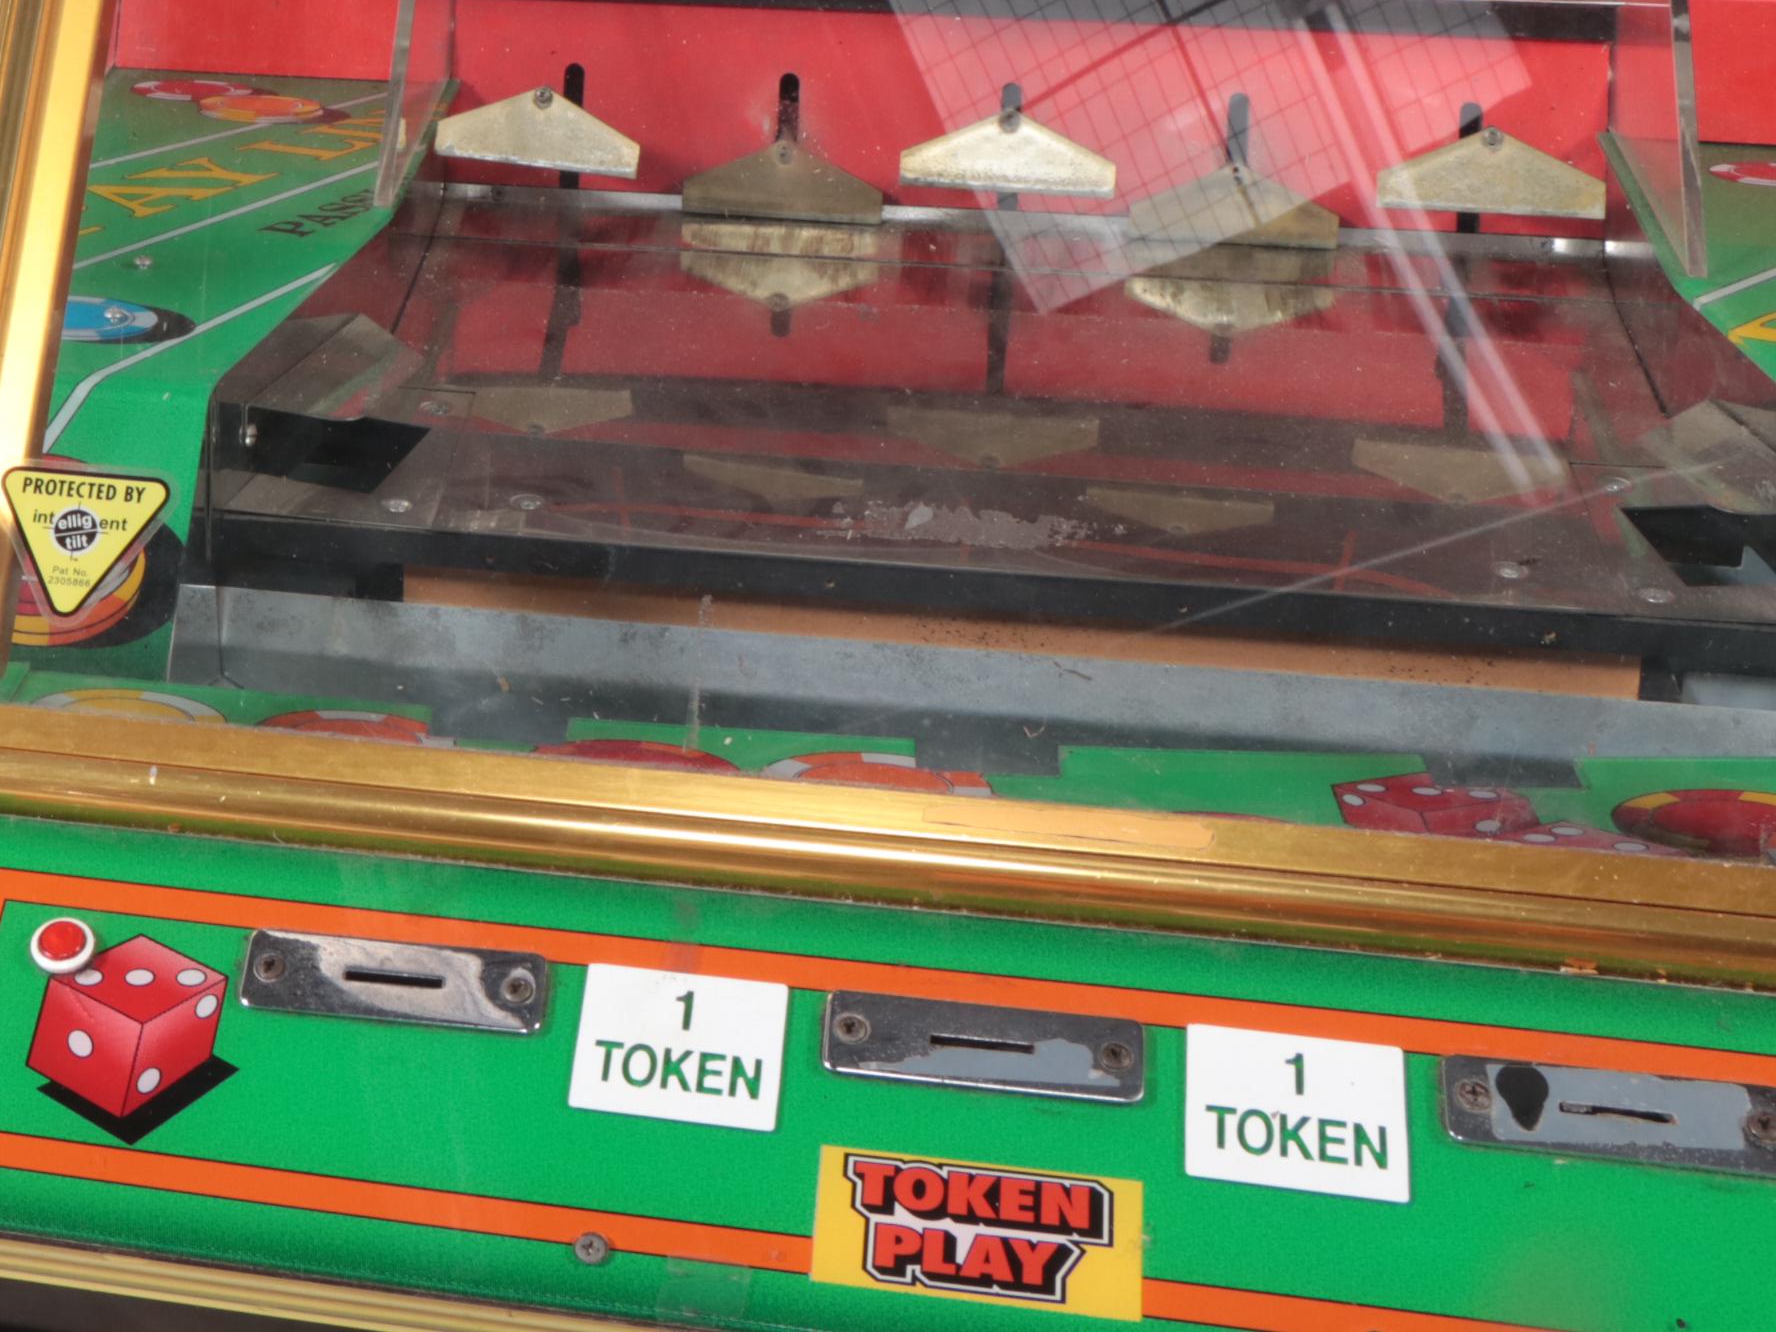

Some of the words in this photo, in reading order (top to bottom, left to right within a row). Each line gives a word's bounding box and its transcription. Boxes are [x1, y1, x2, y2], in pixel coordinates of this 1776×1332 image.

[22, 476, 117, 501] PROTECTED
[123, 485, 146, 504] BY
[65, 534, 89, 550] tilt
[675, 989, 696, 1032] 1
[595, 1039, 763, 1100] TOKEN
[1284, 1051, 1306, 1097] 1
[1205, 1104, 1388, 1170] TOKEN
[852, 1159, 1096, 1233] TOKEN
[874, 1222, 1061, 1288] PLAY
